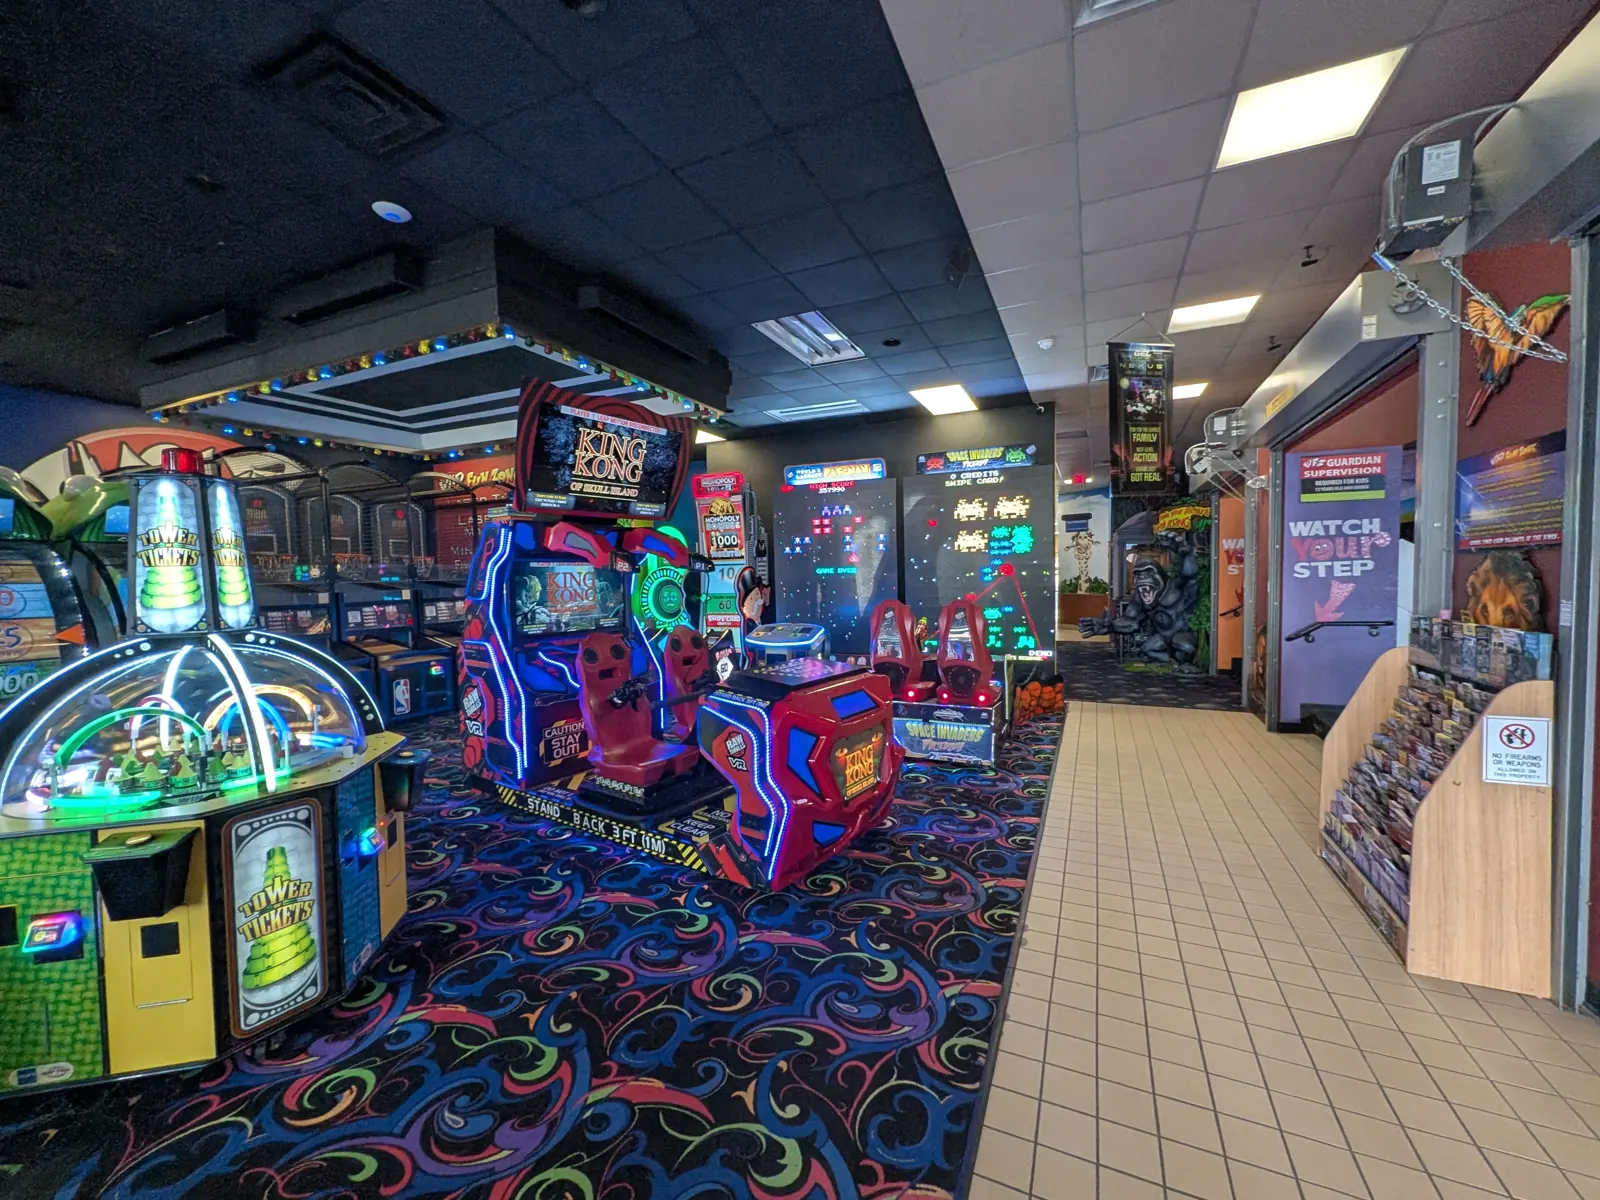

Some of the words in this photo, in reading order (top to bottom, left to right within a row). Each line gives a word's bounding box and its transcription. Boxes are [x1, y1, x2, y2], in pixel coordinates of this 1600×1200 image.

[570, 408, 590, 418] PLAYER
[579, 427, 647, 463] KING
[1133, 433, 1157, 442] FAMILY
[946, 450, 969, 462] SPACE
[969, 447, 1005, 460] INVADERS
[1133, 453, 1158, 462] ACTION
[1327, 456, 1381, 467] GUARDIAN
[572, 450, 643, 482] KONG
[1304, 466, 1380, 478] SUPERVISION
[466, 471, 489, 487] FUN
[491, 467, 516, 481] ZON
[702, 477, 736, 487] MONOPOLY
[945, 479, 972, 487] SWIPE
[976, 476, 1004, 485] CARD!
[960, 470, 999, 480] CREDITS
[1131, 473, 1143, 482] GOT
[1144, 473, 1161, 482] REAL
[570, 482, 582, 491] OF
[583, 483, 610, 495] SKULL
[610, 486, 638, 497] ISLAND
[705, 515, 740, 523] MONOPOLY
[138, 522, 198, 546] TOWER
[1289, 518, 1380, 537] WATCH
[212, 527, 242, 546] TOWER
[711, 535, 737, 546] 1000
[137, 547, 200, 567] TICKETS
[213, 547, 245, 567] TICKETS
[617, 562, 629, 571] P2
[695, 562, 705, 570] P1
[1293, 560, 1375, 578] STEP
[546, 571, 596, 590] KING
[546, 588, 596, 605] KONG
[719, 600, 732, 610] 60
[0, 627, 21, 648] 5
[463, 688, 480, 711] RAW
[465, 720, 483, 736] VR
[544, 721, 585, 738] CAUTION
[906, 722, 936, 738] SPACE
[936, 724, 985, 743] INVADERS
[552, 732, 581, 749] STAY
[726, 733, 744, 750] RAW
[553, 743, 580, 759] OUT!
[845, 744, 874, 769] KING
[1505, 753, 1542, 761] FIREARMS
[728, 756, 747, 771] VR
[1506, 760, 1541, 768] WEAPONS
[845, 760, 874, 786] KONG
[711, 810, 732, 818] NO
[527, 798, 560, 818] STAND
[573, 811, 606, 834] BACK
[612, 825, 621, 839] 3
[622, 829, 637, 843] FT
[641, 833, 666, 854] (1M)
[670, 822, 708, 837] CLEAR
[683, 818, 716, 830] KEEP
[238, 875, 313, 918] TOWER
[237, 899, 315, 942] TICKETS
